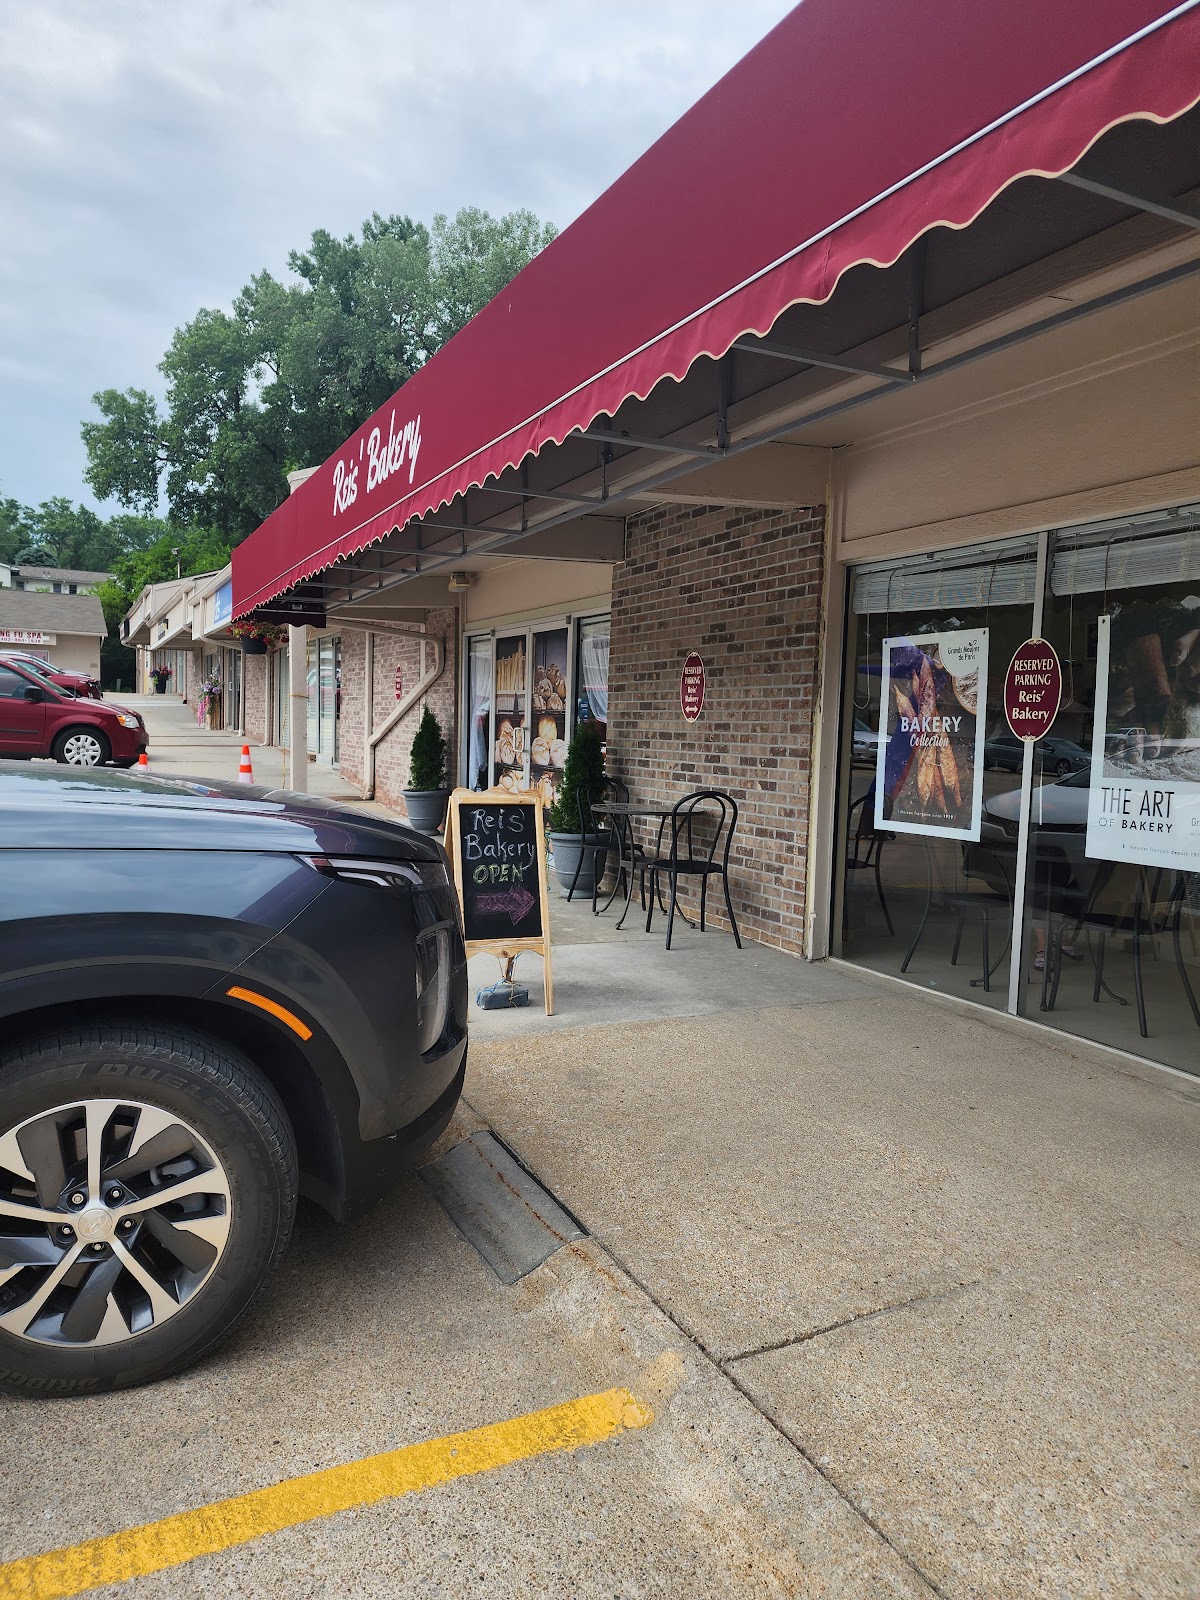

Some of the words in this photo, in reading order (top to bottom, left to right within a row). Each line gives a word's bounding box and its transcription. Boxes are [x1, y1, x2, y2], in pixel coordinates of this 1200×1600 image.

[367, 408, 422, 493] Bakery
[14, 631, 23, 639] FU
[26, 631, 42, 639] SPA
[1014, 659, 1054, 672] RESERVED
[1014, 673, 1052, 686] PARKING
[1018, 690, 1045, 703] Reis'
[1011, 707, 1050, 724] Bakery
[900, 716, 962, 733] BAKERY
[910, 733, 950, 747] Collection
[1101, 787, 1132, 815] THE
[1139, 790, 1175, 819] ART
[1098, 817, 1116, 828] OF
[1121, 819, 1173, 834] BAKERY
[464, 831, 536, 870] Bakery
[472, 862, 525, 885] OPEN
